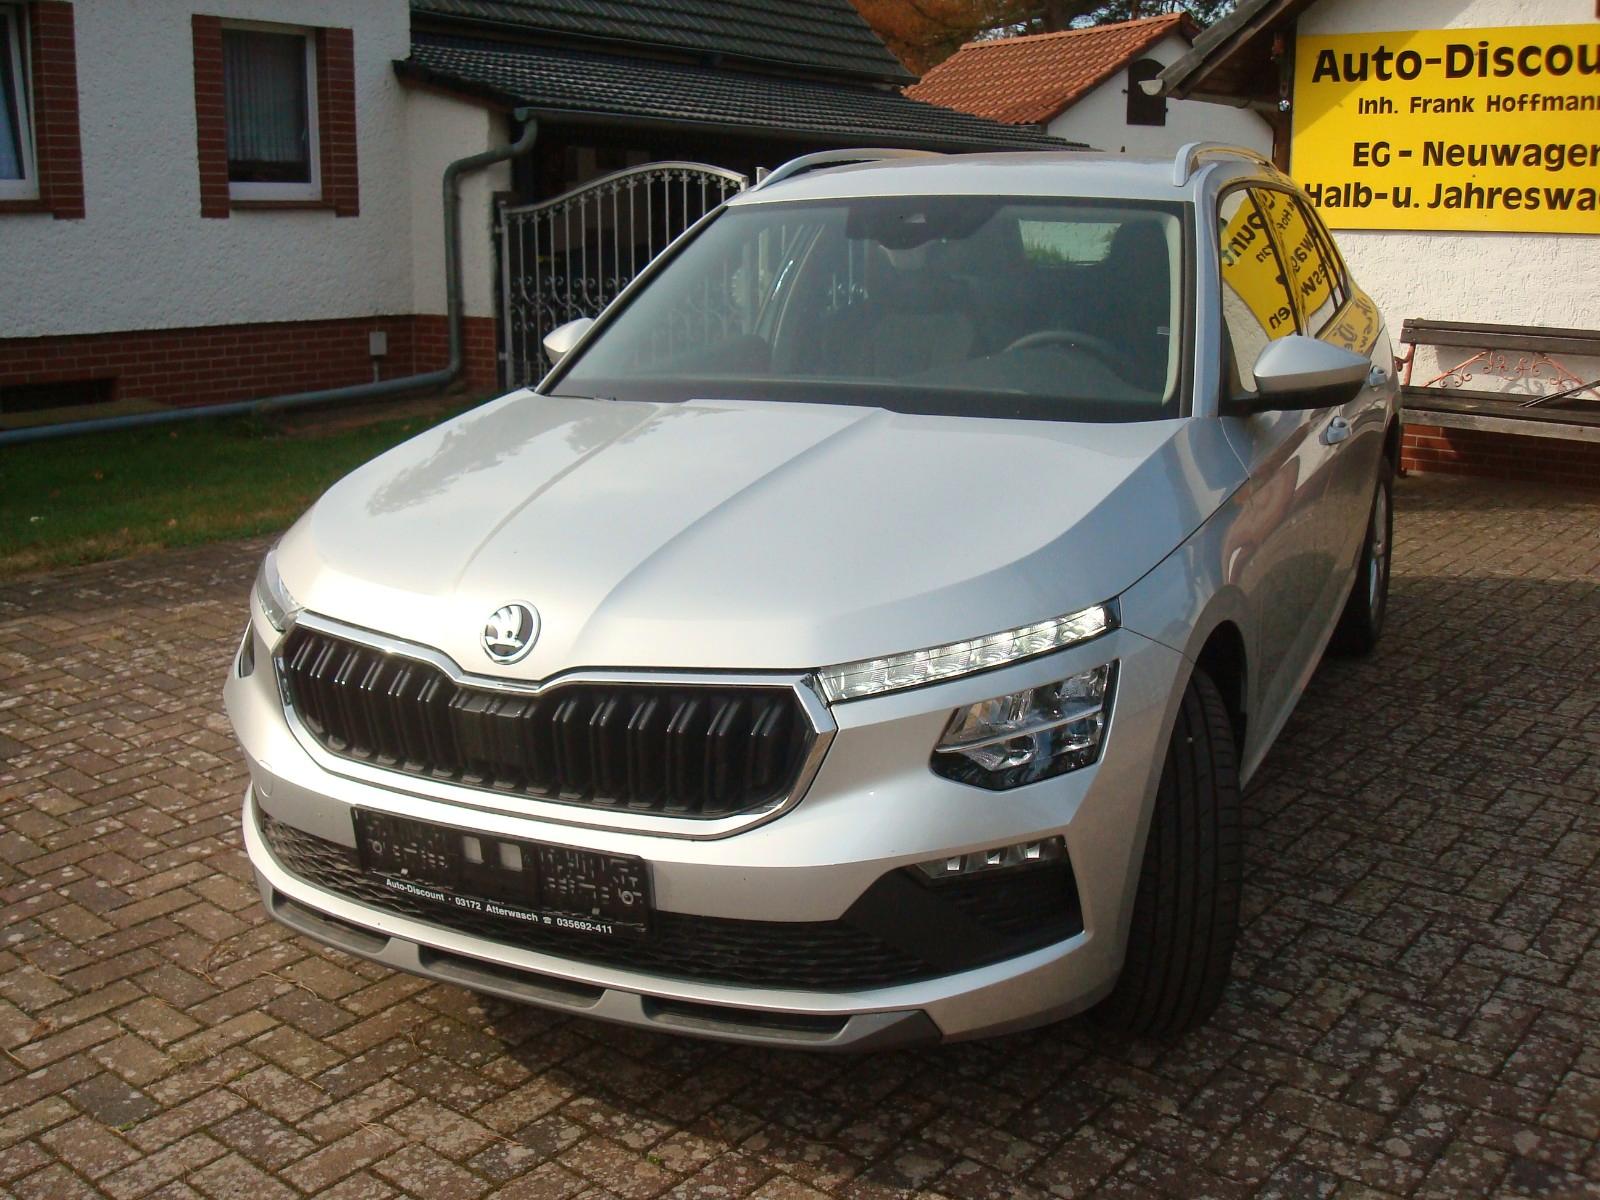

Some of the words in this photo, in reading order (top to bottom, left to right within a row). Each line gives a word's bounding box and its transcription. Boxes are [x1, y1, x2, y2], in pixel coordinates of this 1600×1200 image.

[1358, 96, 1398, 115] Inh.
[1410, 96, 1475, 114] Frank
[1486, 93, 1600, 112] Hoffman
[1353, 141, 1391, 167] EG
[1427, 182, 1600, 211] Jahreswa
[386, 878, 445, 902] Auto-Discount
[455, 897, 481, 910] 03172
[486, 904, 538, 922] Atterwasch
[556, 917, 613, 934] 035692-411
